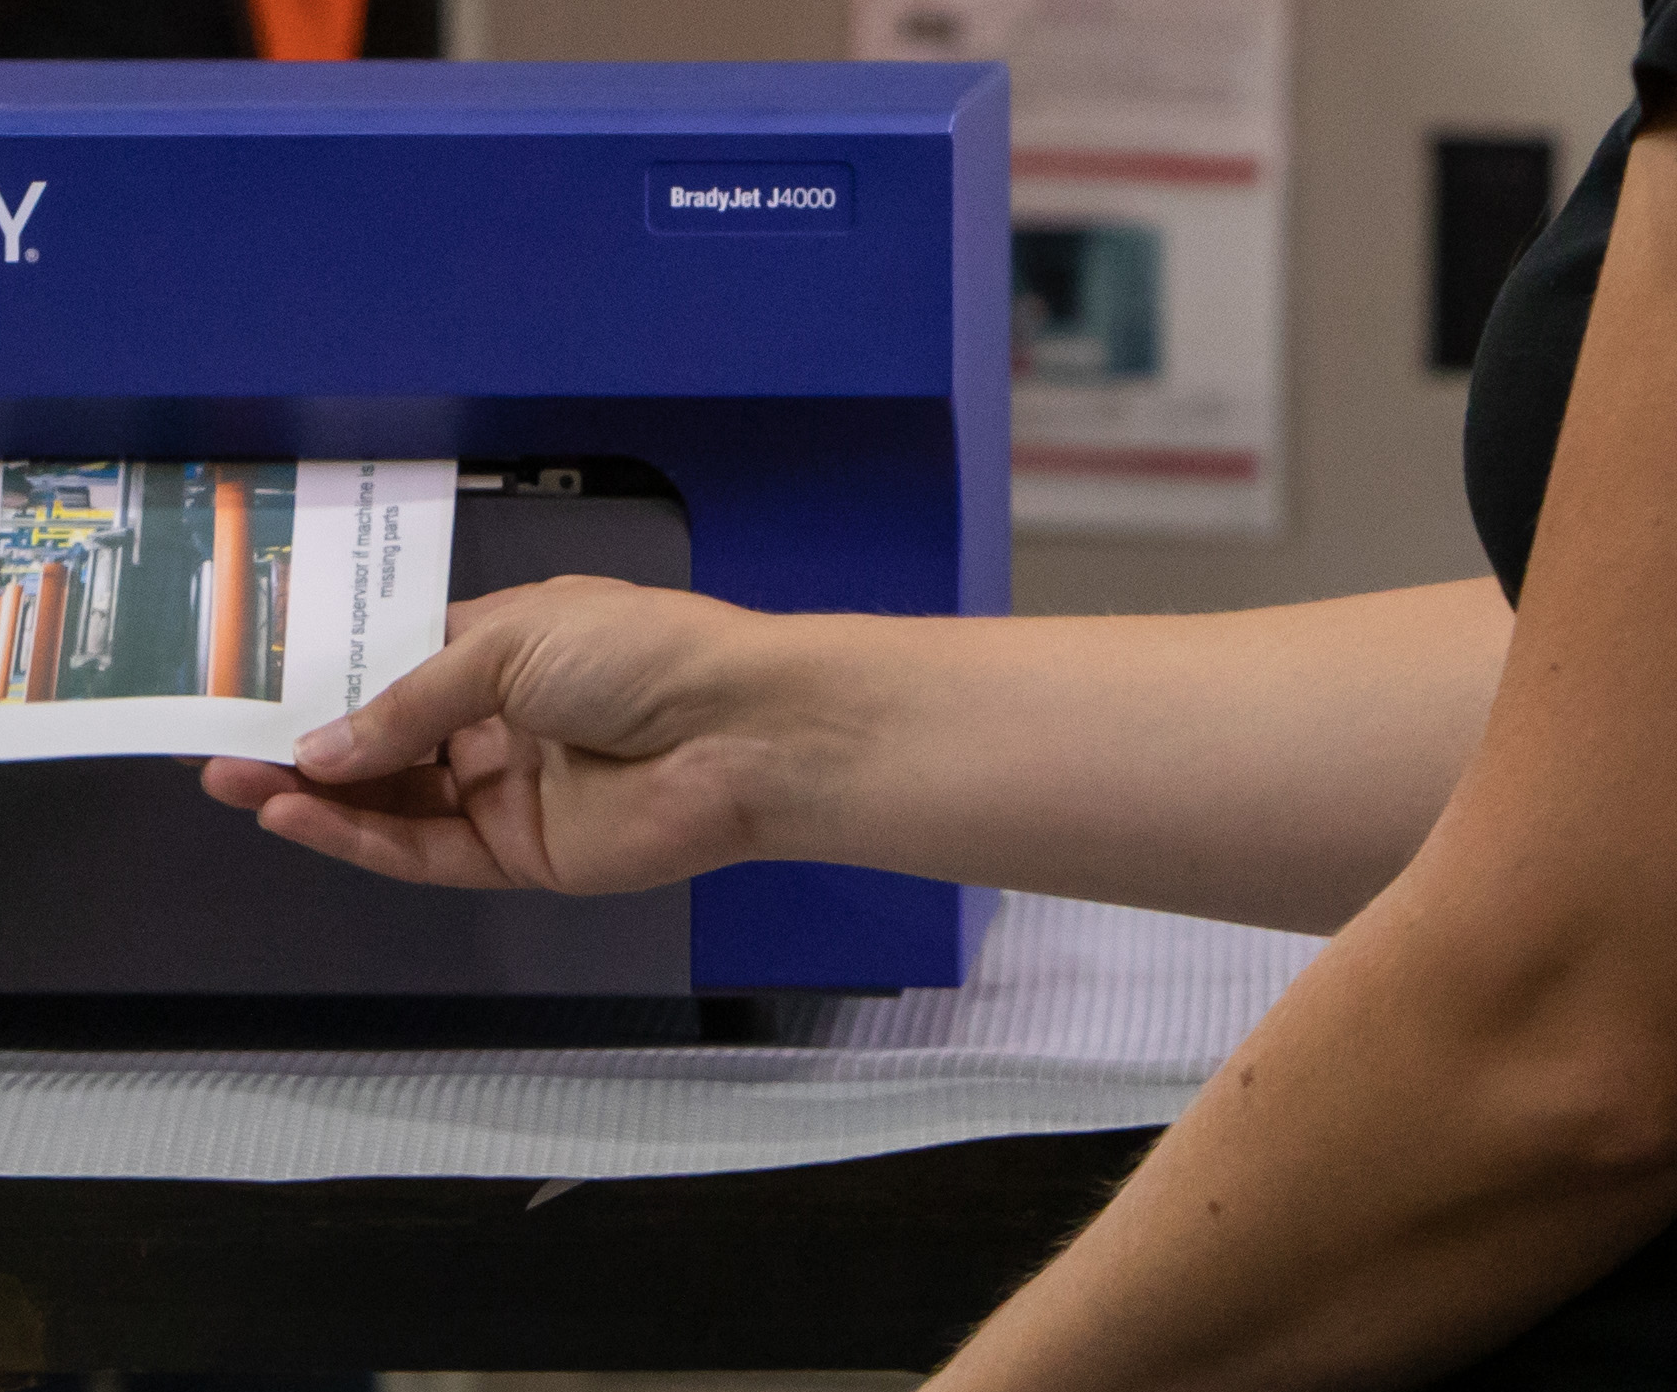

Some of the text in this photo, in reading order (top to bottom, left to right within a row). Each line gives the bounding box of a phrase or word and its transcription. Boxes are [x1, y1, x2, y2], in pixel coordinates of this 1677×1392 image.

[669, 186, 837, 212] BradyJet J4000
[355, 482, 375, 547] machine
[380, 505, 402, 598] missing parts
[350, 562, 370, 636] supervisor
[349, 640, 368, 670] your
